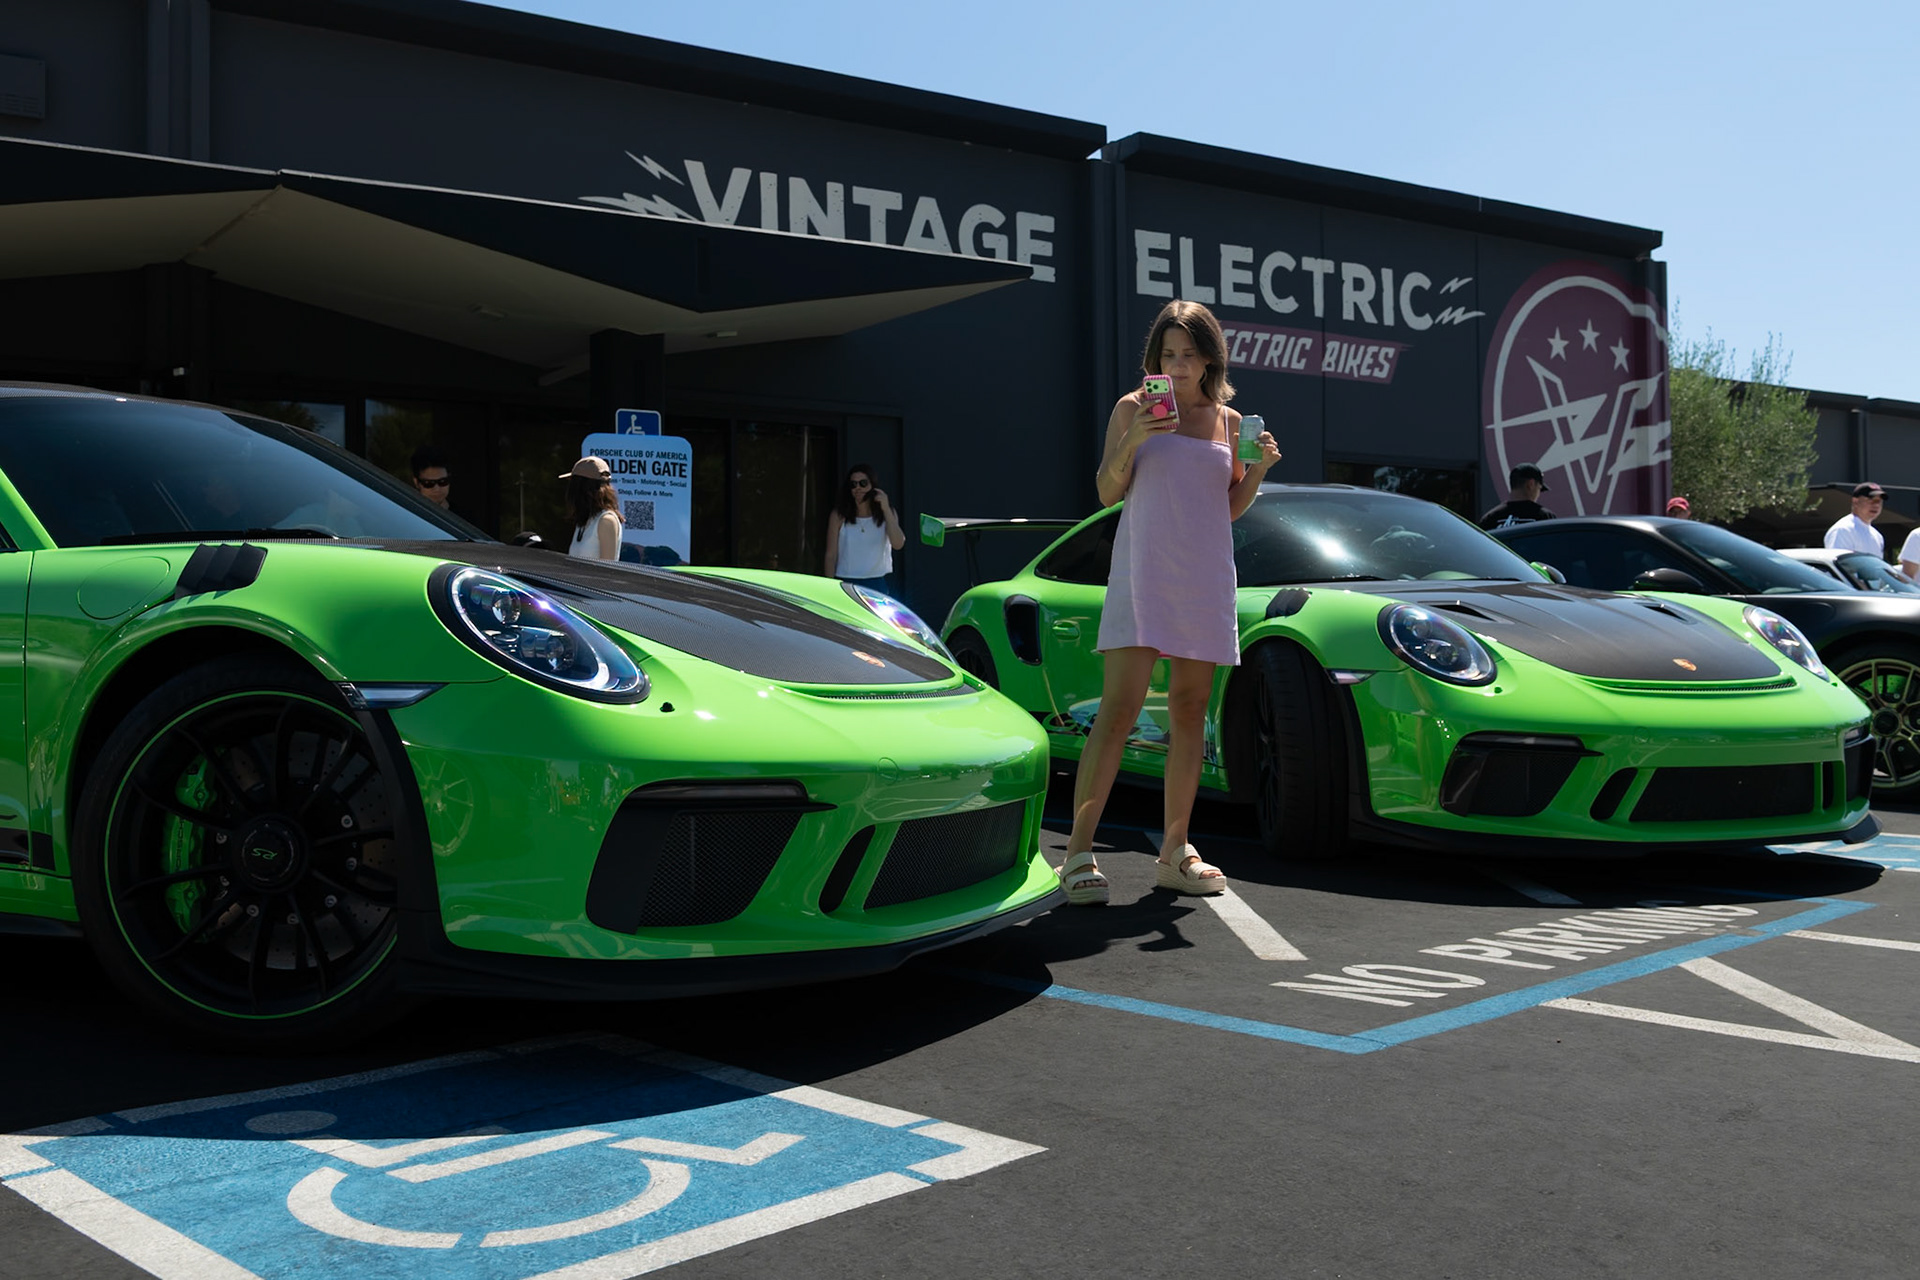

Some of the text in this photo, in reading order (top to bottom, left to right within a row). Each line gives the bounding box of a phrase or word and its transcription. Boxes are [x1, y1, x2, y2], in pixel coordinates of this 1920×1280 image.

[683, 159, 1434, 331] VINTAGE ELECTRIC
[1321, 340, 1395, 379] BIKES
[589, 448, 688, 461] PORSCHE CLUB OF AMERICA
[603, 458, 688, 478] LDEN GATE
[641, 478, 666, 487] Motoring
[669, 480, 687, 488] Social
[1269, 902, 1759, 1007] NO PARKING
